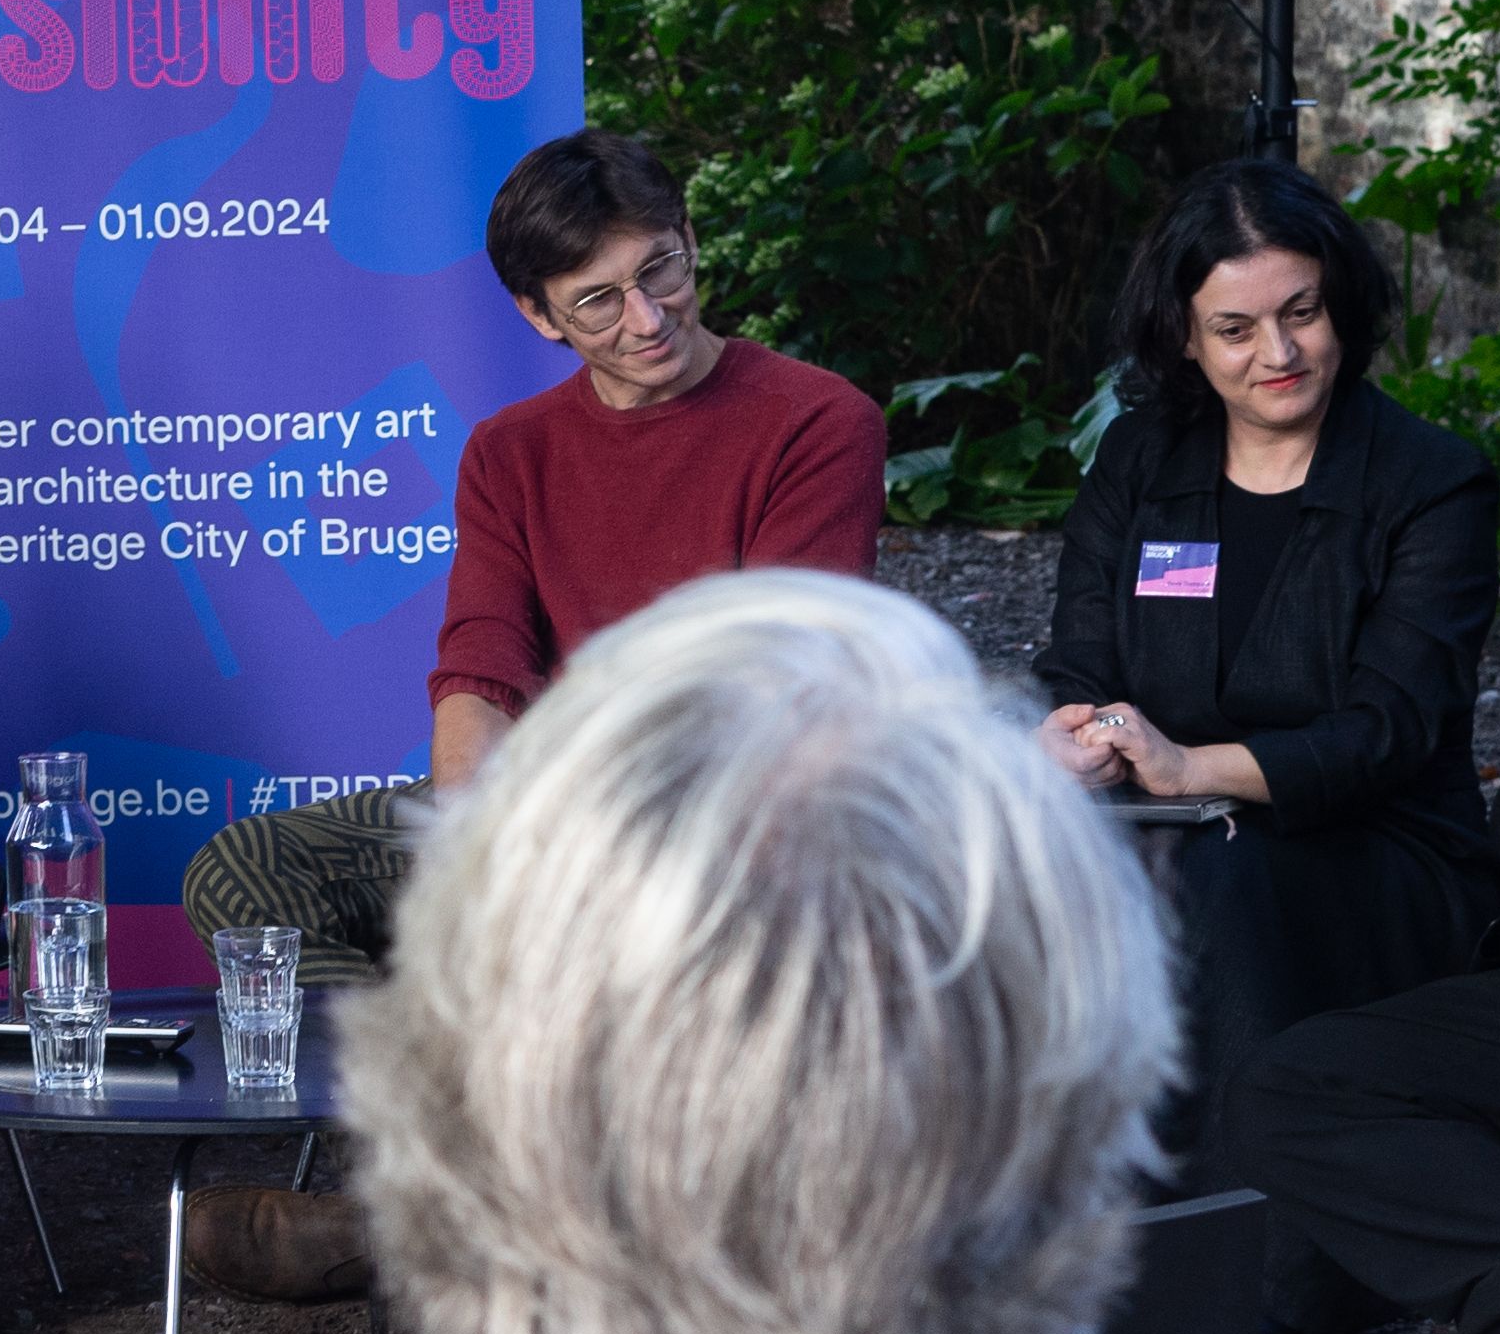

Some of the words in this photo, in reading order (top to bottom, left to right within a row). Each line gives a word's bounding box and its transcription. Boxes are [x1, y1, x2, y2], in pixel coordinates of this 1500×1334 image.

[99, 198, 330, 240] 01.09.2024
[51, 411, 360, 451] contemporary
[376, 403, 436, 438] art
[269, 462, 303, 498] in
[317, 460, 388, 497] the
[161, 522, 247, 567] City
[263, 519, 305, 556] of
